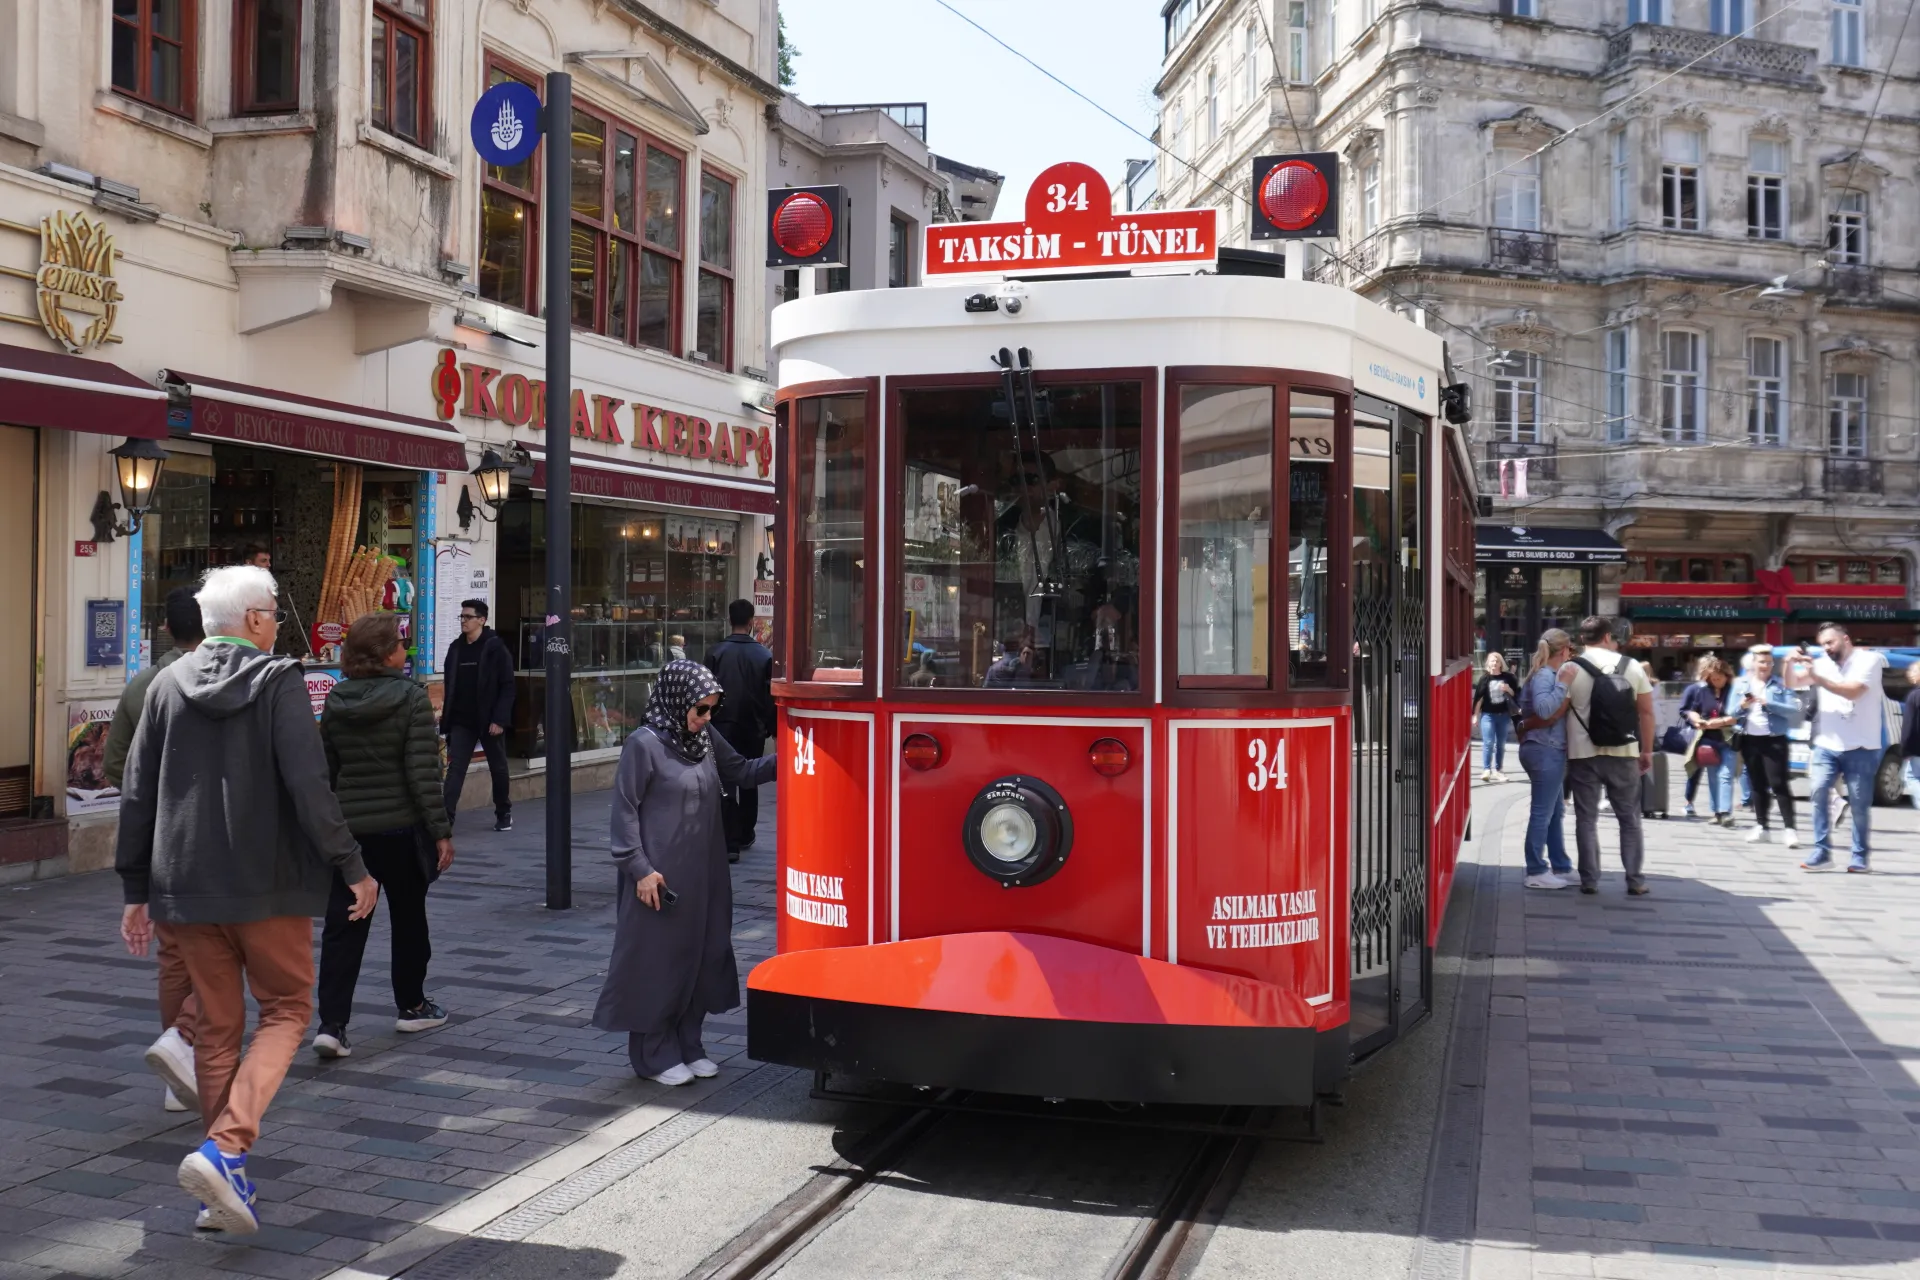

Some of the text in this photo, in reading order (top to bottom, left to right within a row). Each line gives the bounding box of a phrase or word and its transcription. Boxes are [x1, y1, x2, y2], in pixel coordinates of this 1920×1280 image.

[1046, 182, 1090, 213] 34
[938, 226, 1062, 264] TAKSİM
[1097, 221, 1205, 258] TÜNEL
[234, 411, 438, 467] BEYOĞLU KONAK KEBAP SALONU
[631, 403, 758, 467] KEBAP
[623, 480, 656, 501] KONAK
[665, 485, 693, 506] KEBAP
[700, 490, 731, 509] SALONU
[79, 544, 94, 554] 255
[1507, 551, 1525, 559] SETA
[1525, 551, 1549, 559] SILVER
[1555, 552, 1576, 560] GOLD
[1684, 609, 1739, 617] VITAVIEN
[1847, 610, 1896, 618] VITAVIEN
[90, 708, 116, 720] KONA
[794, 726, 816, 775] 34
[1247, 738, 1289, 792] 34
[986, 791, 1026, 802] CARATREN
[809, 873, 844, 900] YASAK
[1211, 889, 1317, 920] ASILMAK YASAK
[1206, 917, 1320, 949] VE TEHLIKELIDIR
